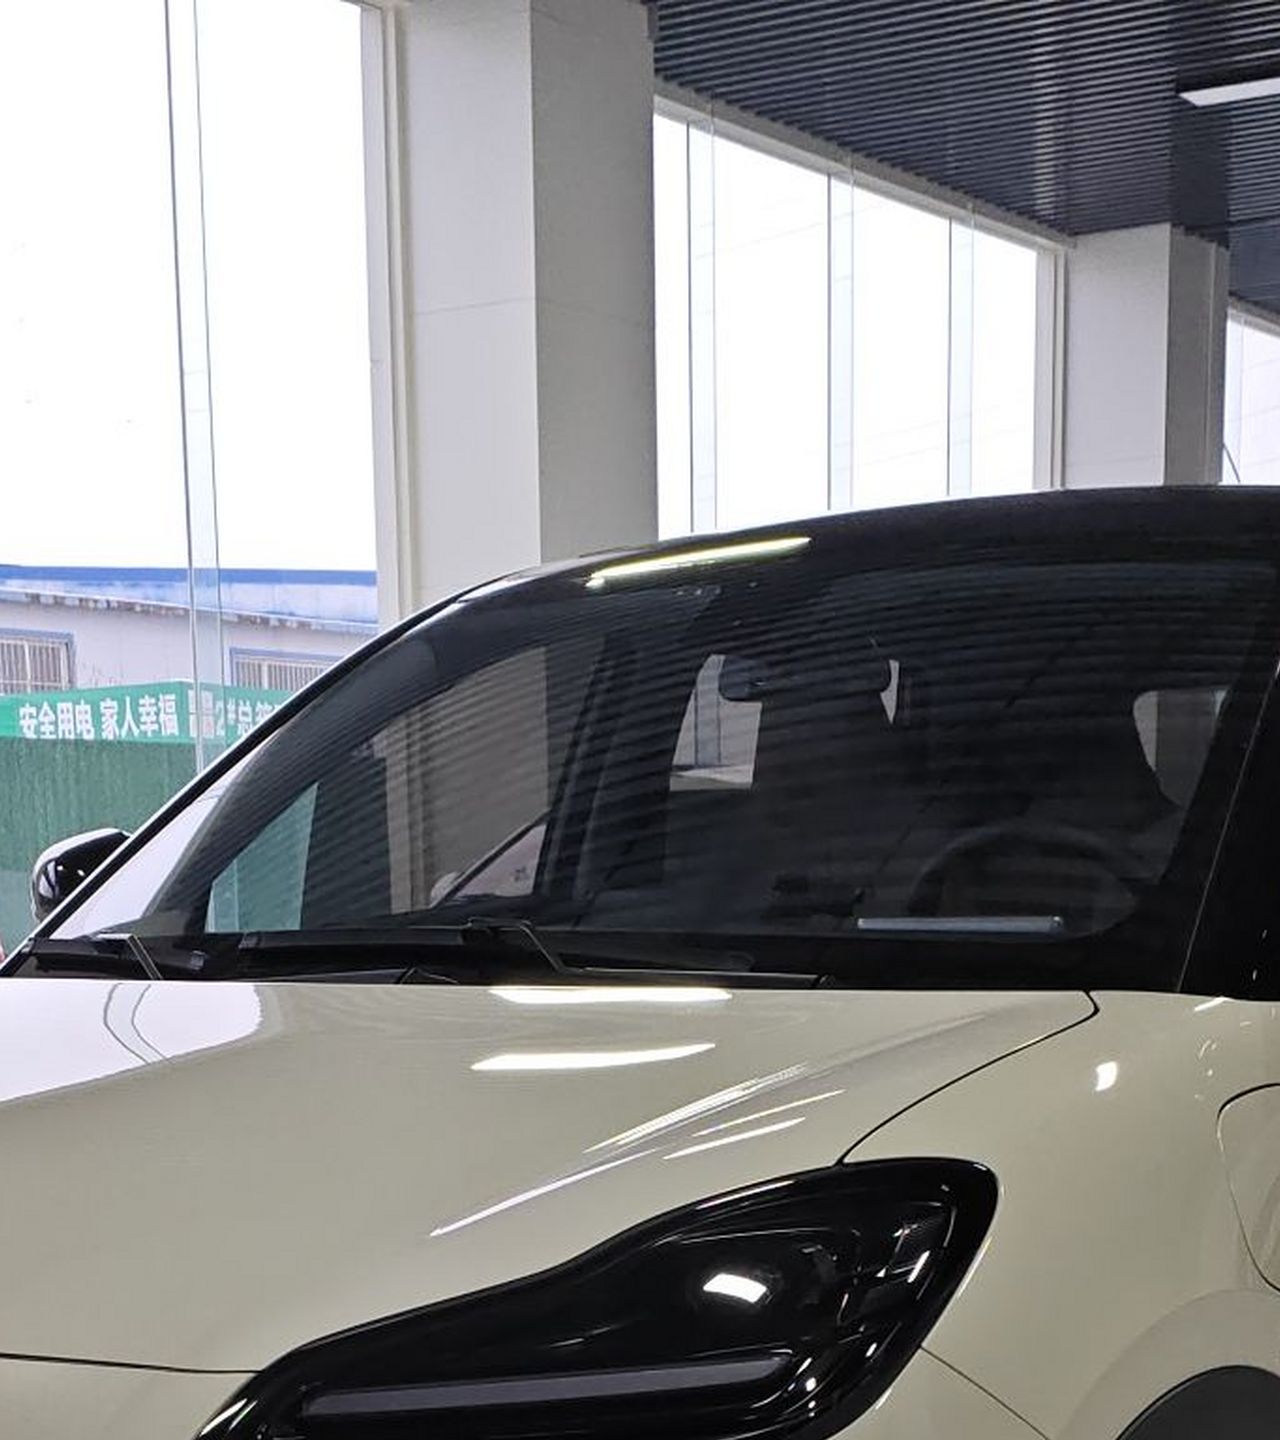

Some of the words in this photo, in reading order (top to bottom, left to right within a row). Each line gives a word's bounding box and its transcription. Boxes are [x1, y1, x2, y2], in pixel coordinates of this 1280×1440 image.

[19, 699, 95, 740] 安全用电
[99, 693, 179, 740] 家人幸福
